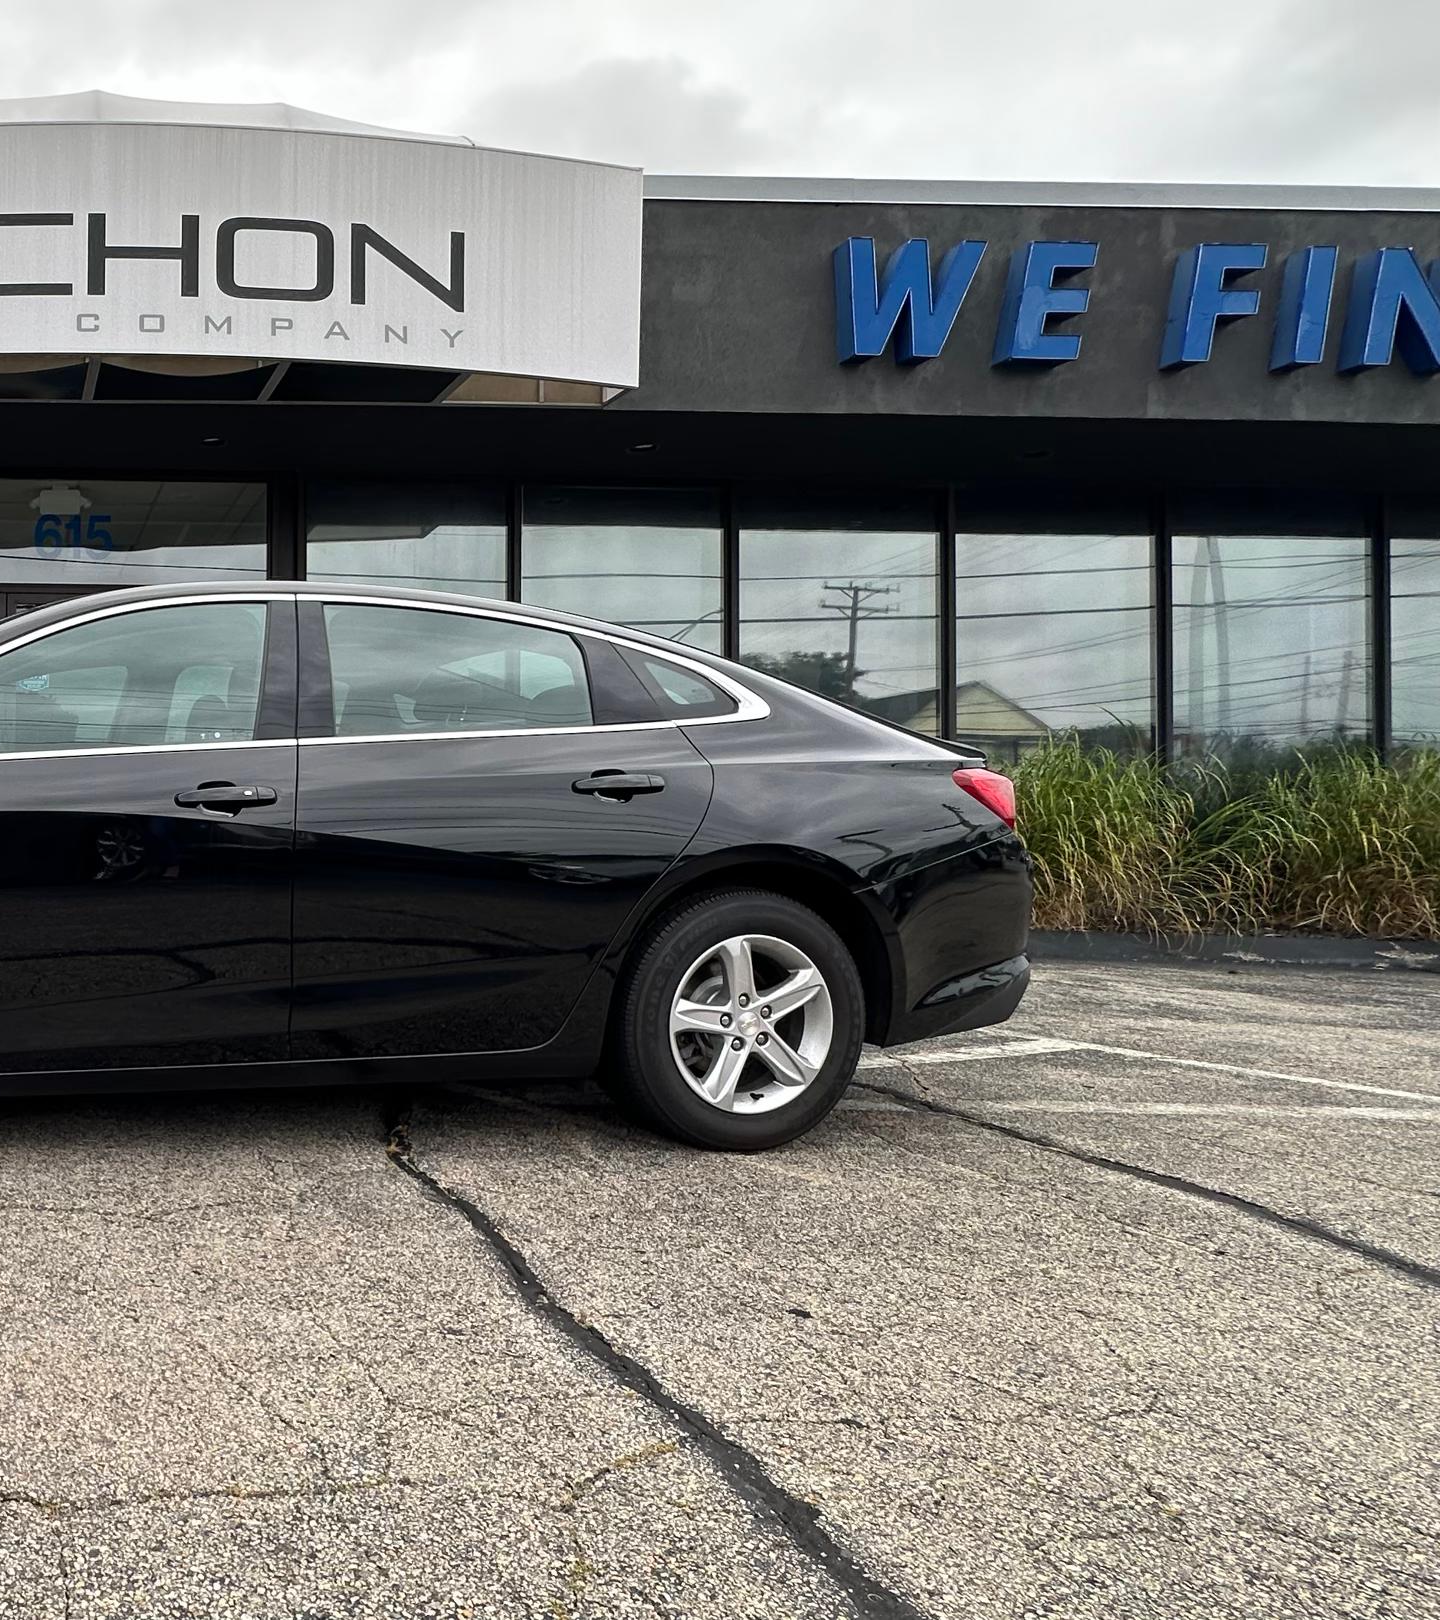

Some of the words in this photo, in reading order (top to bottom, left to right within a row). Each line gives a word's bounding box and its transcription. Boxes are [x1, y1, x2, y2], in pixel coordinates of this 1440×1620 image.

[835, 236, 1100, 363] WE
[75, 313, 464, 348] COMPANY
[34, 513, 113, 559] 615
